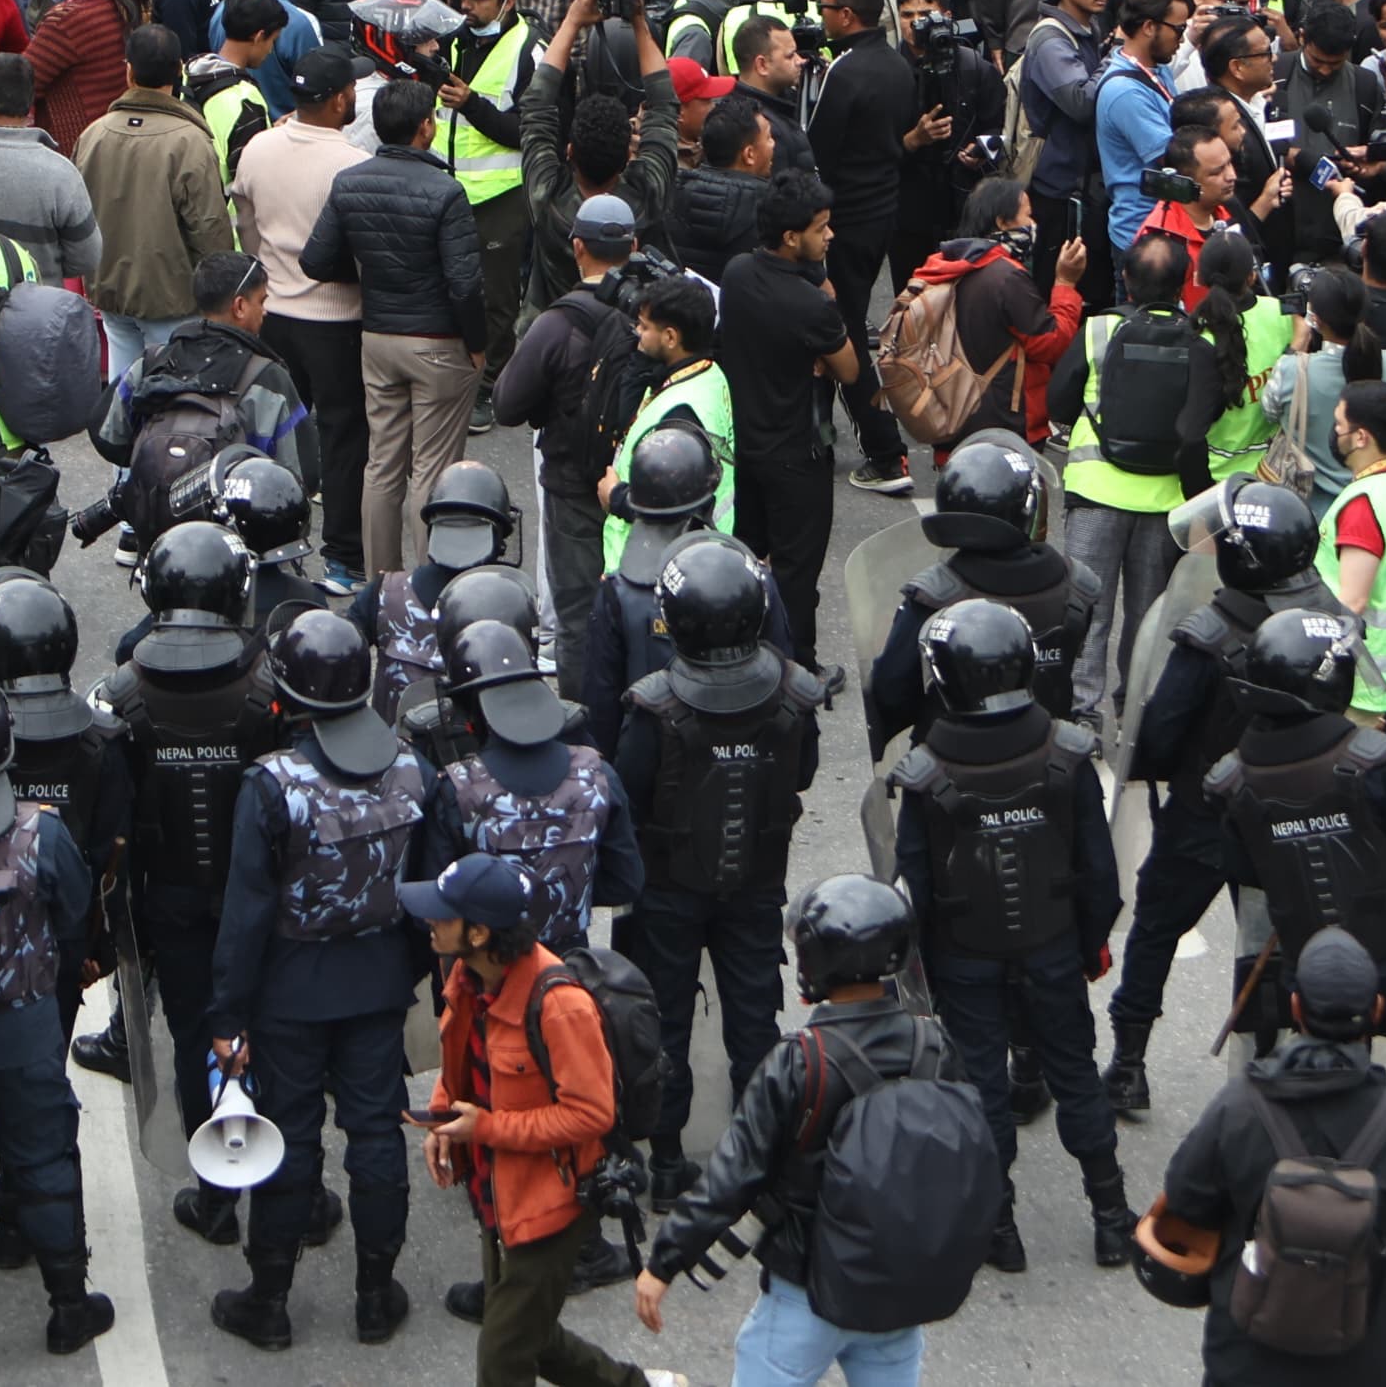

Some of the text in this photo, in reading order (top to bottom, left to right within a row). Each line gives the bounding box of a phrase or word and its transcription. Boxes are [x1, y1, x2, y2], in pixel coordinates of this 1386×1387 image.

[157, 746, 237, 760] NEPAL POLICE
[712, 745, 759, 759] PAL POL
[28, 785, 68, 797] POLICE
[980, 807, 1045, 826] PAL POLICE
[1271, 813, 1349, 838] NEPAL POLICE
